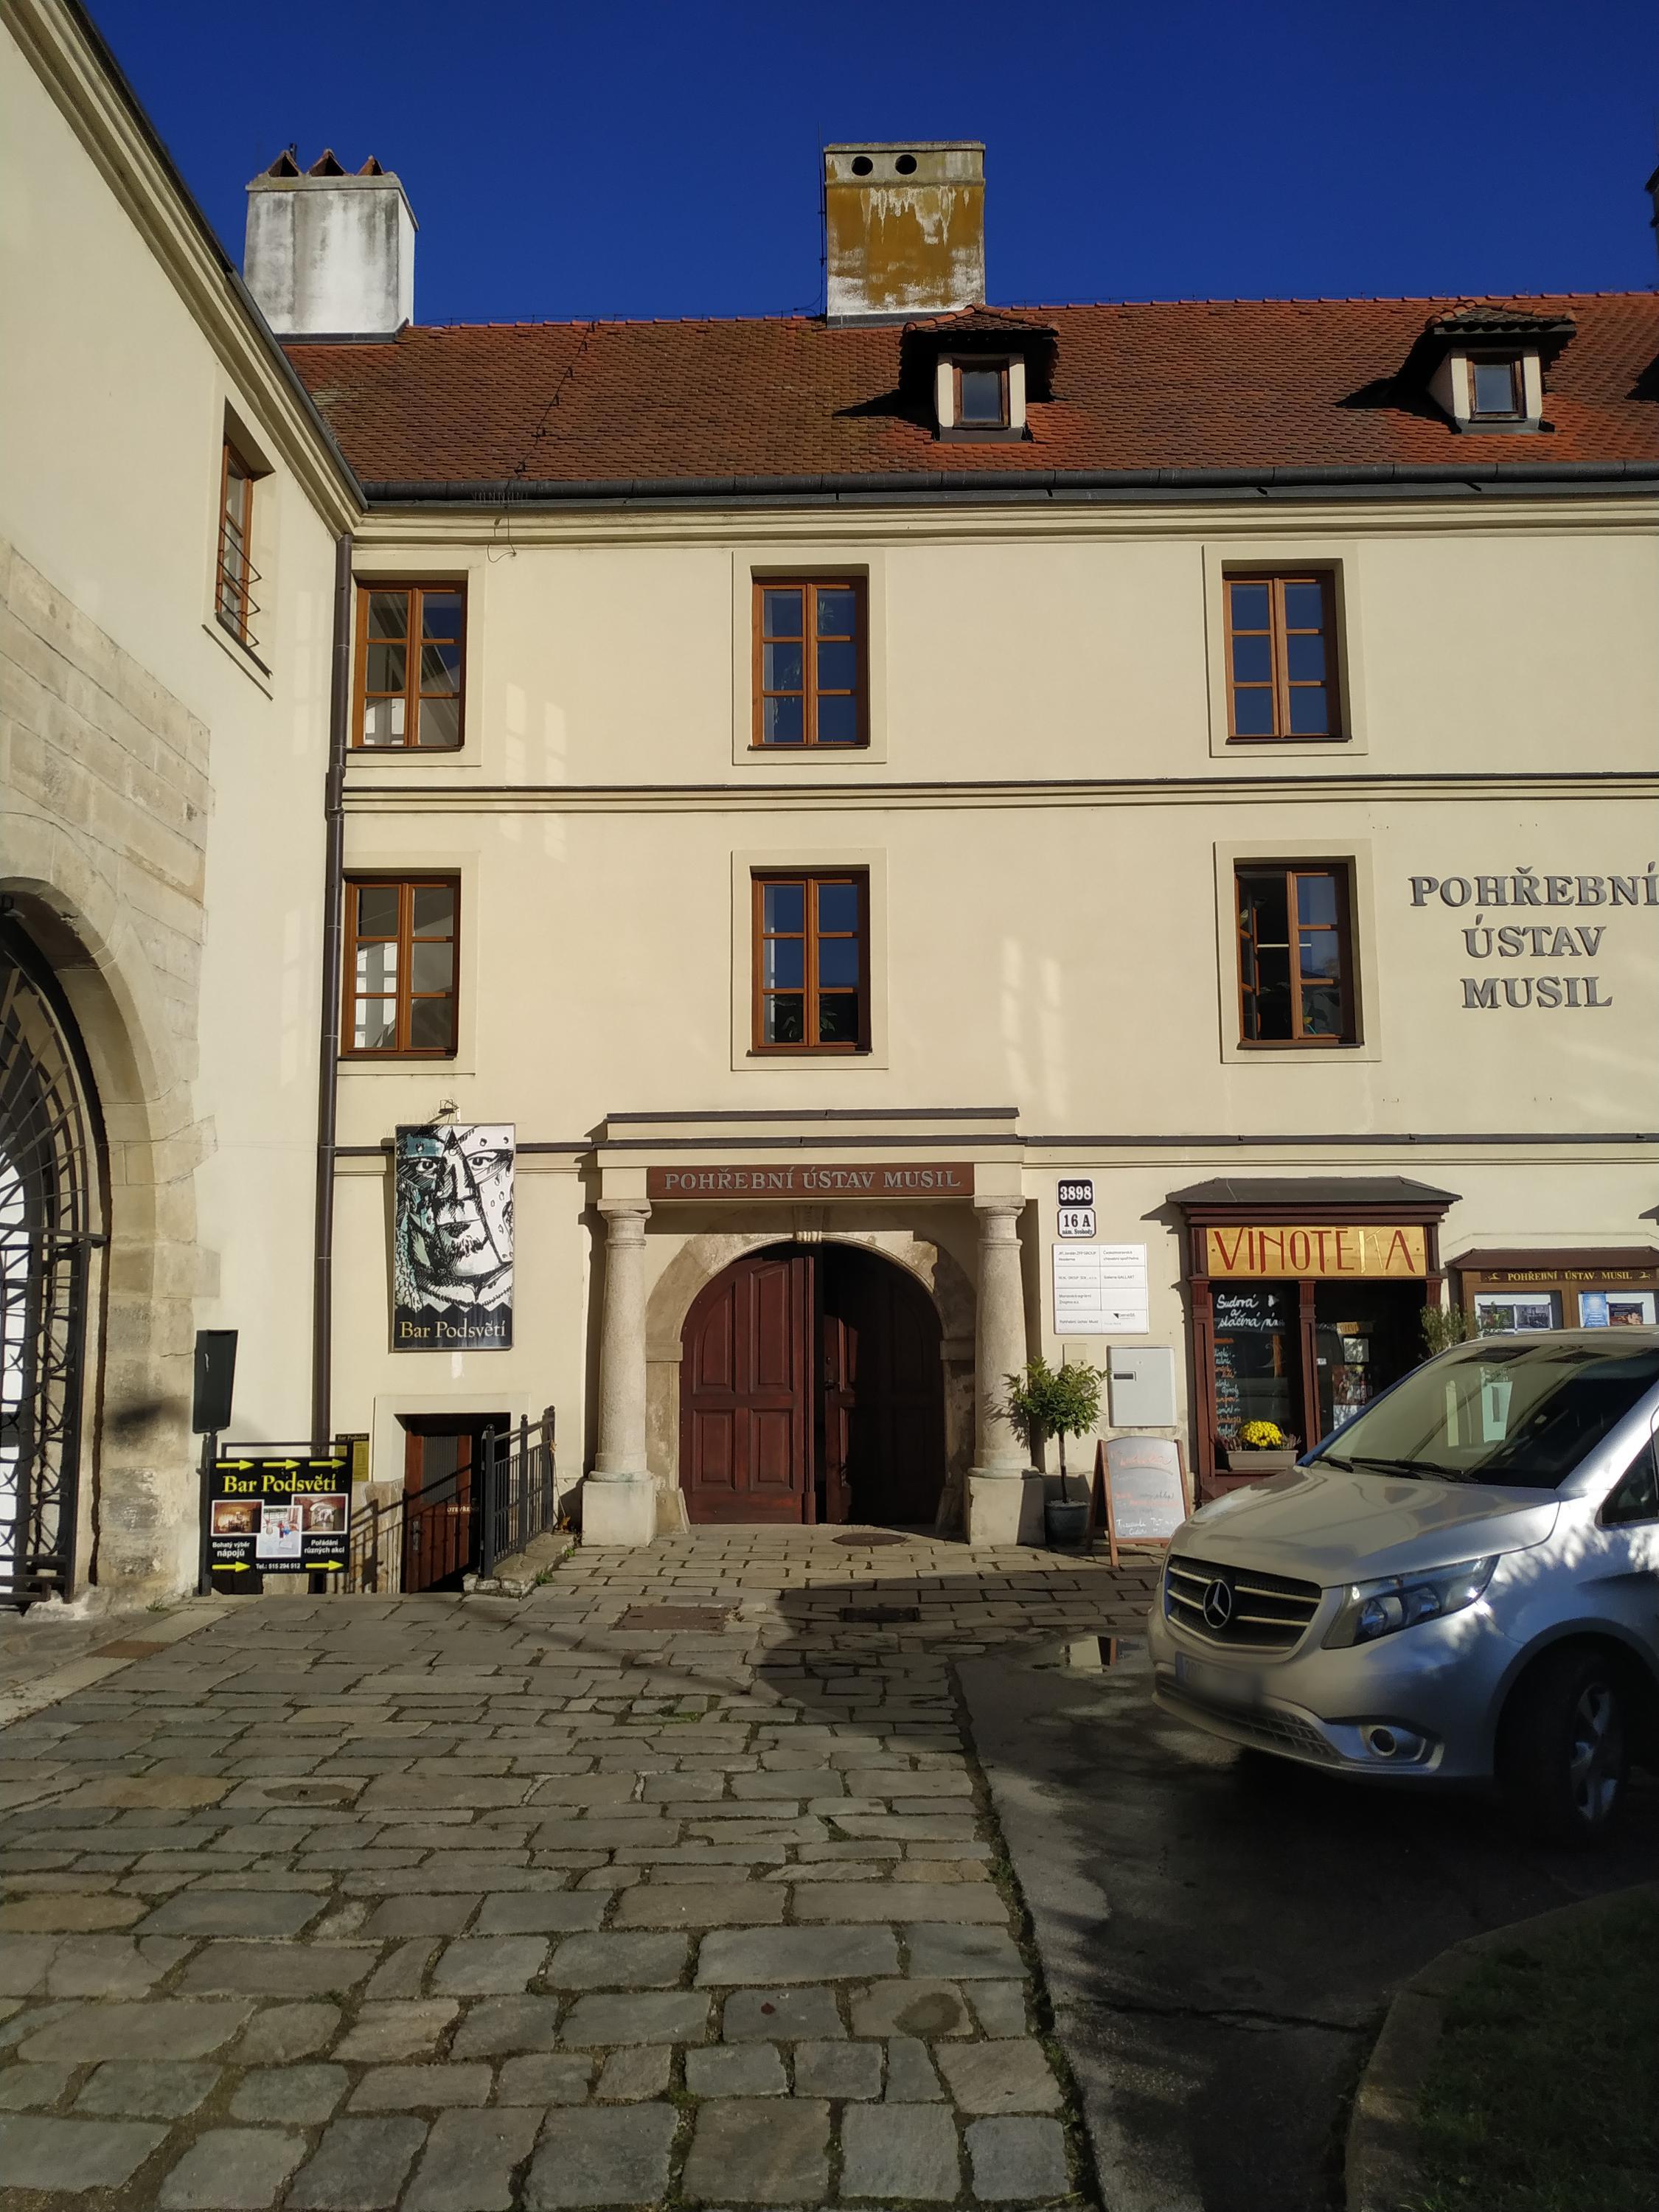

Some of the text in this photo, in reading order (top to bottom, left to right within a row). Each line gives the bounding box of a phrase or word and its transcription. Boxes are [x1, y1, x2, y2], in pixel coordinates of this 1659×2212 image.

[1408, 861, 1659, 907] POHŘEBNÍ
[1461, 914, 1607, 959] ÚSTAV
[1460, 975, 1613, 1009] MUSIL
[664, 1166, 961, 1190] POHŘEBNÍ ÚSTAV MUSIL
[1060, 1186, 1092, 1200] 3898
[1063, 1214, 1091, 1228] 16 A
[1508, 1270, 1632, 1281] POHŘEBNÍ ÚSTAV MUSIL
[1216, 1293, 1259, 1309] Sudová
[400, 1318, 507, 1338] Bar Podsvětí
[222, 1471, 337, 1493] Bar Podsvětí
[310, 1538, 338, 1546] Pořádání
[331, 1545, 345, 1554] akcí
